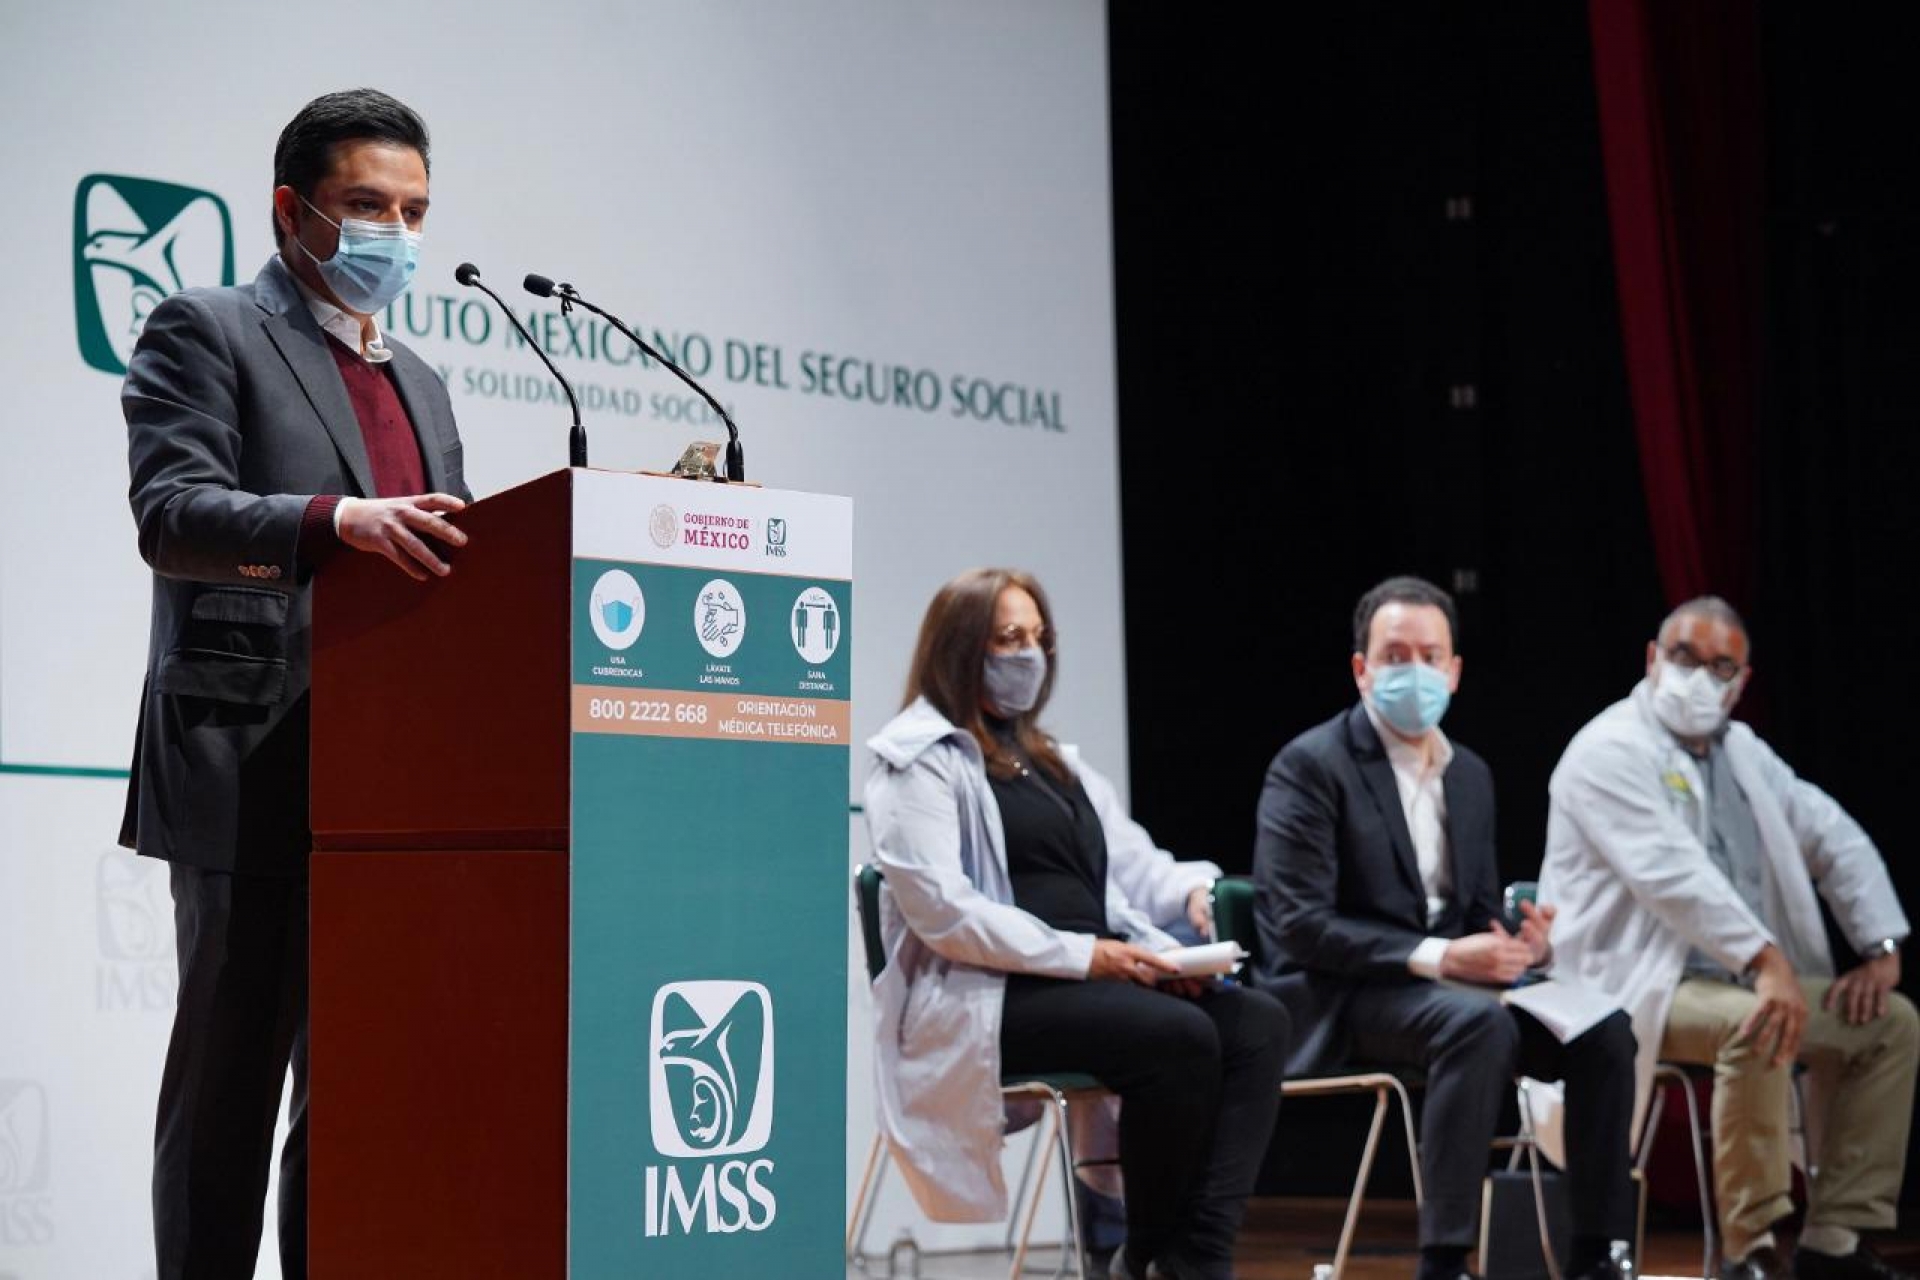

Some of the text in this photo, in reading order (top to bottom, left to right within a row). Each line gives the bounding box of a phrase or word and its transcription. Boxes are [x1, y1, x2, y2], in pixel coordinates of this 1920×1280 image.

[504, 309, 712, 378] MEXICANO
[724, 337, 790, 390] DEL
[799, 350, 942, 413] SEGURO
[950, 373, 1067, 434] SOCIAL
[684, 513, 749, 529] GOBIERNO DE
[684, 527, 749, 550] MÉXICO
[610, 656, 626, 664] USA
[700, 675, 740, 686] LAS MANOS
[799, 681, 834, 691] DISTANCIA
[590, 698, 708, 724] 800 2222 668
[737, 701, 816, 717] ORIENTACIÓN
[719, 717, 837, 738] MÉDICA TELEFÓNICA
[95, 964, 173, 1011] IMS
[644, 1159, 777, 1238] IMSS
